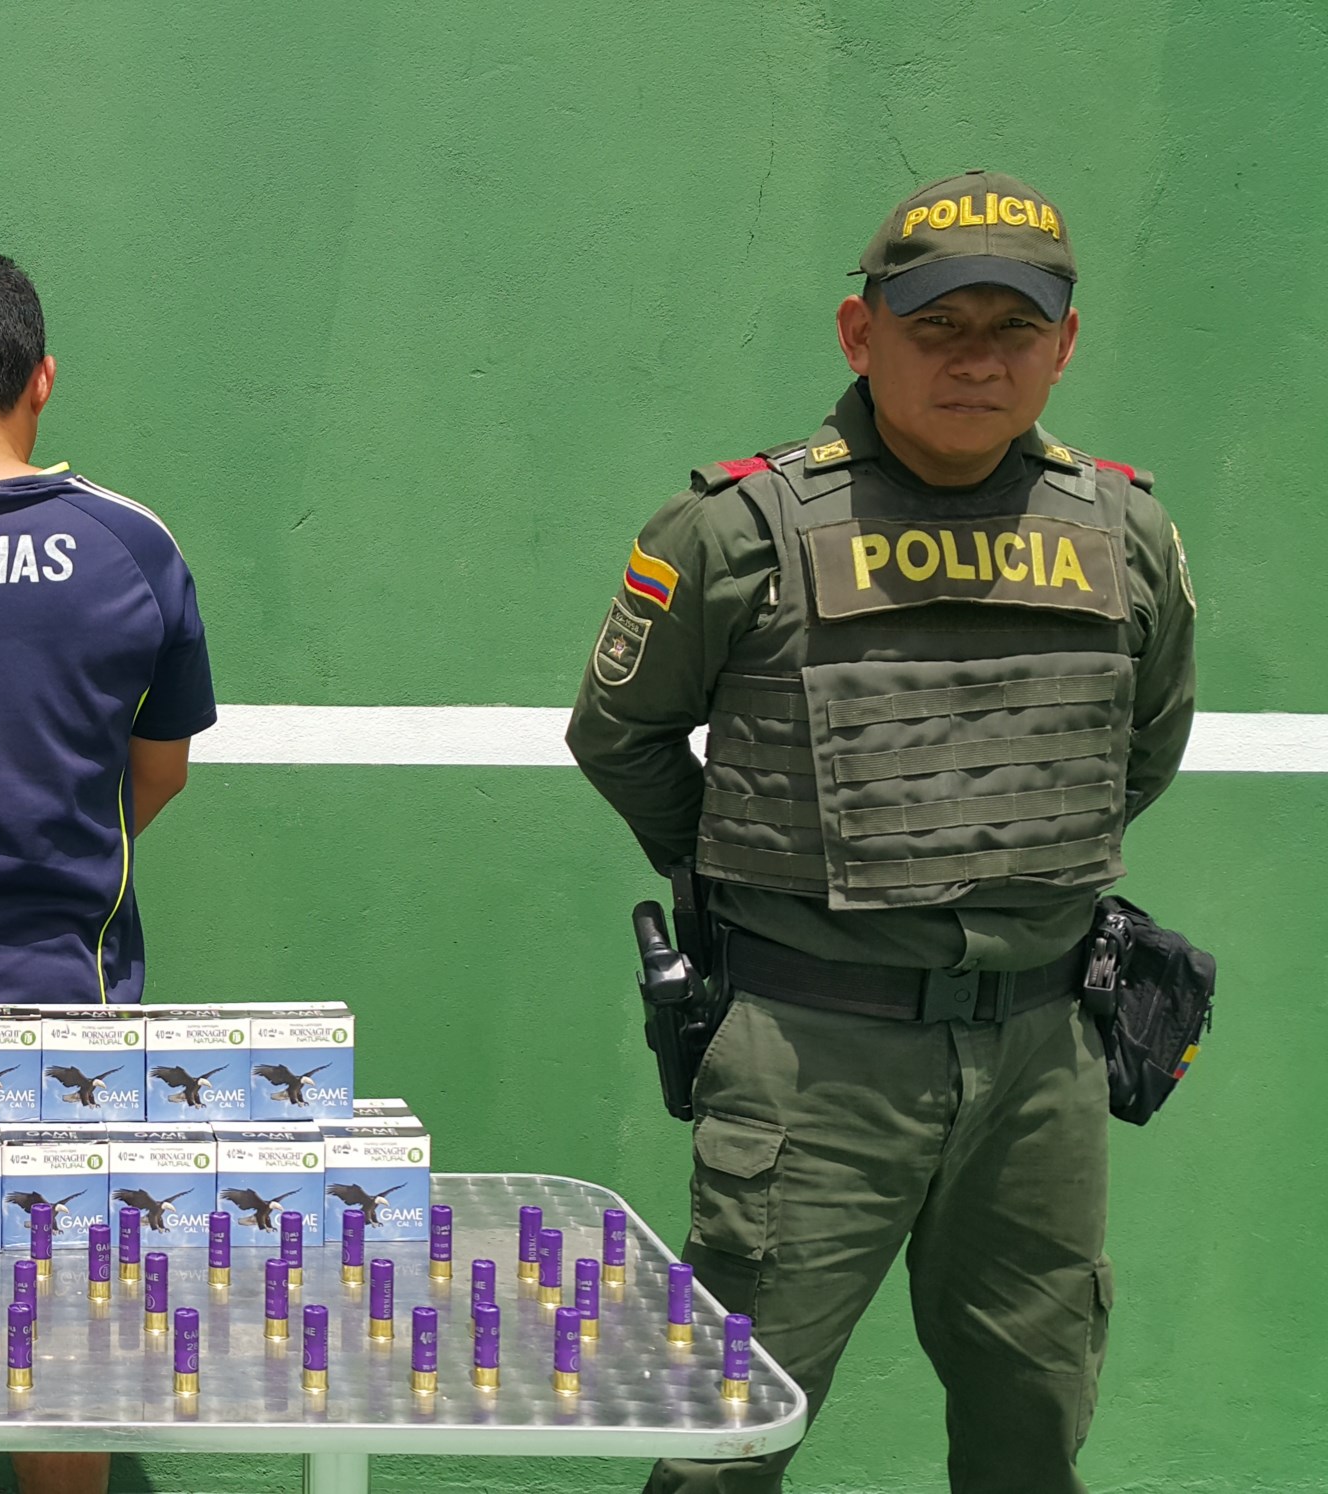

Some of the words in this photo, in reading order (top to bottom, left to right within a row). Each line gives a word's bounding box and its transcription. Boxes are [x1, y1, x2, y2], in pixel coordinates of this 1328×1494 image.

[902, 193, 1060, 239] POLICIA
[851, 530, 1093, 591] POLICIA
[97, 1090, 139, 1102] GAME
[203, 1090, 245, 1102] GAME
[306, 1088, 347, 1100] GAME
[44, 1155, 85, 1163] BORNAGHI
[150, 1153, 191, 1161] BORNAGHI
[259, 1152, 301, 1160] BORNAGHI
[167, 1214, 210, 1226] GAME
[380, 1208, 423, 1220] GAME
[60, 1215, 103, 1227] GAME
